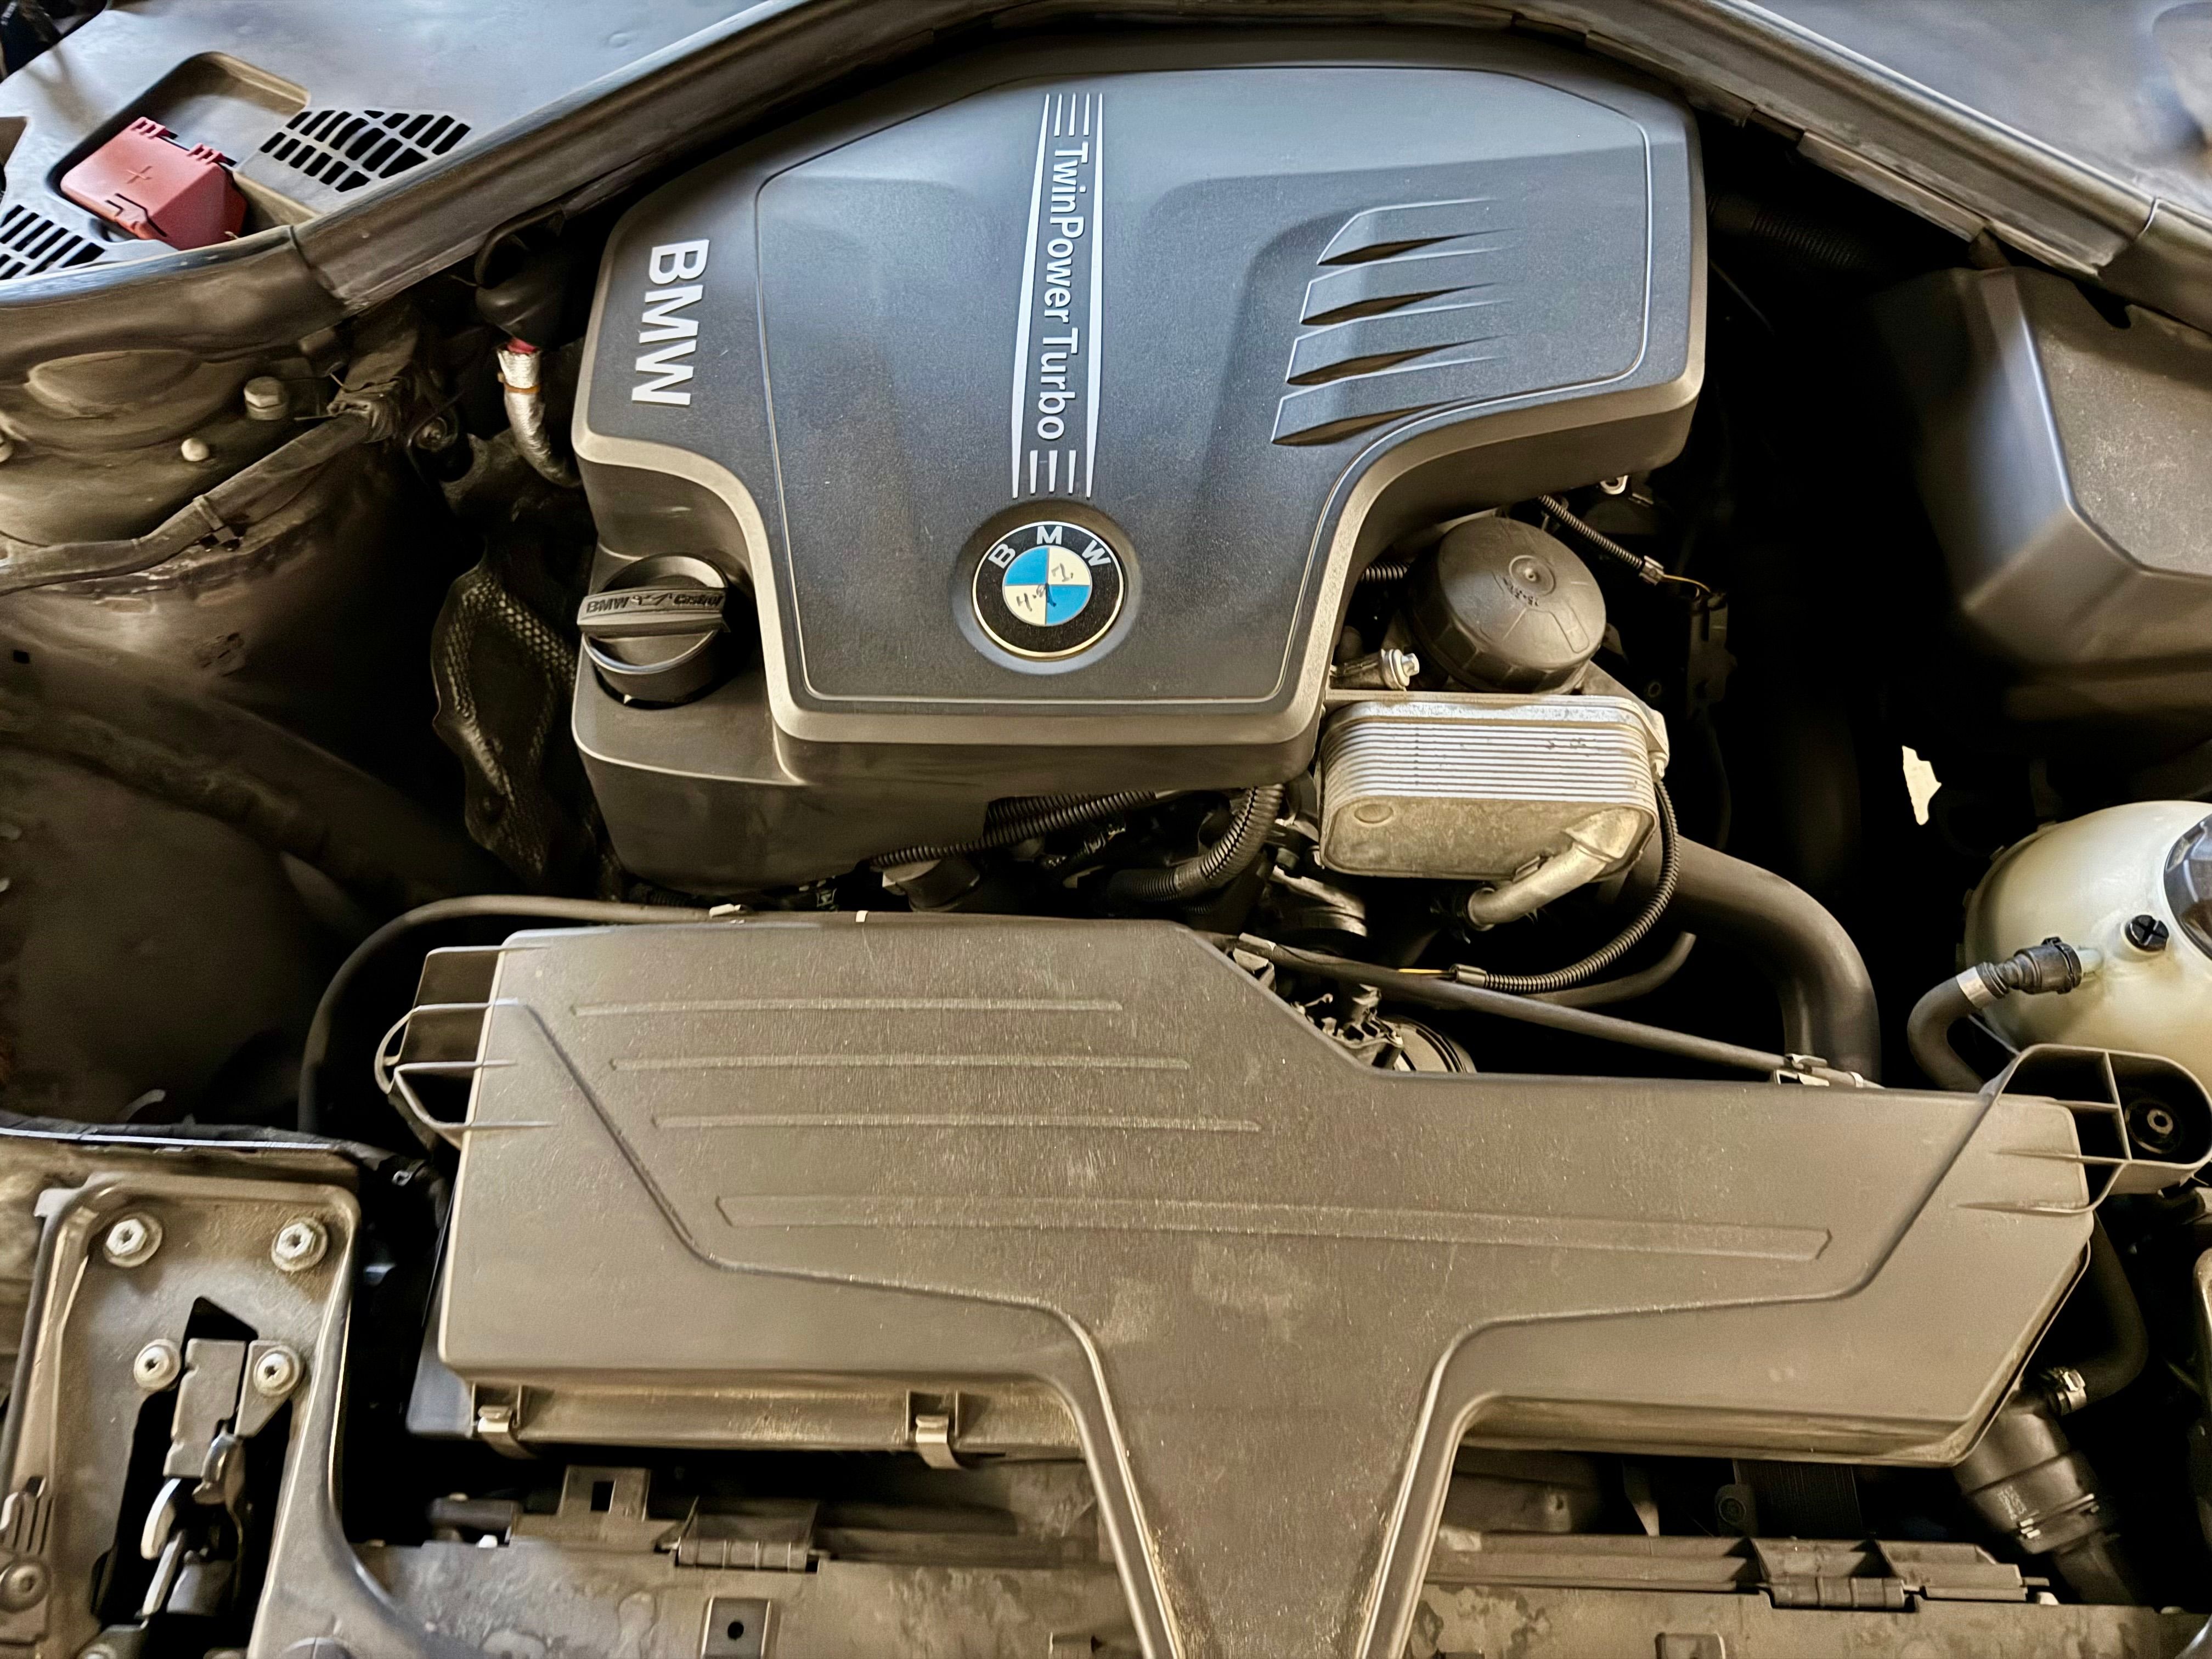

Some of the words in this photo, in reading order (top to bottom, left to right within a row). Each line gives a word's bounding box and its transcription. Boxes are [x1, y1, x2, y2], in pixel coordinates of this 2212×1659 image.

[1043, 141, 1088, 323] TwinPower
[631, 239, 709, 405] BMW
[1037, 328, 1079, 440] Turbo
[988, 525, 1111, 569] BMW
[586, 596, 630, 613] BMW
